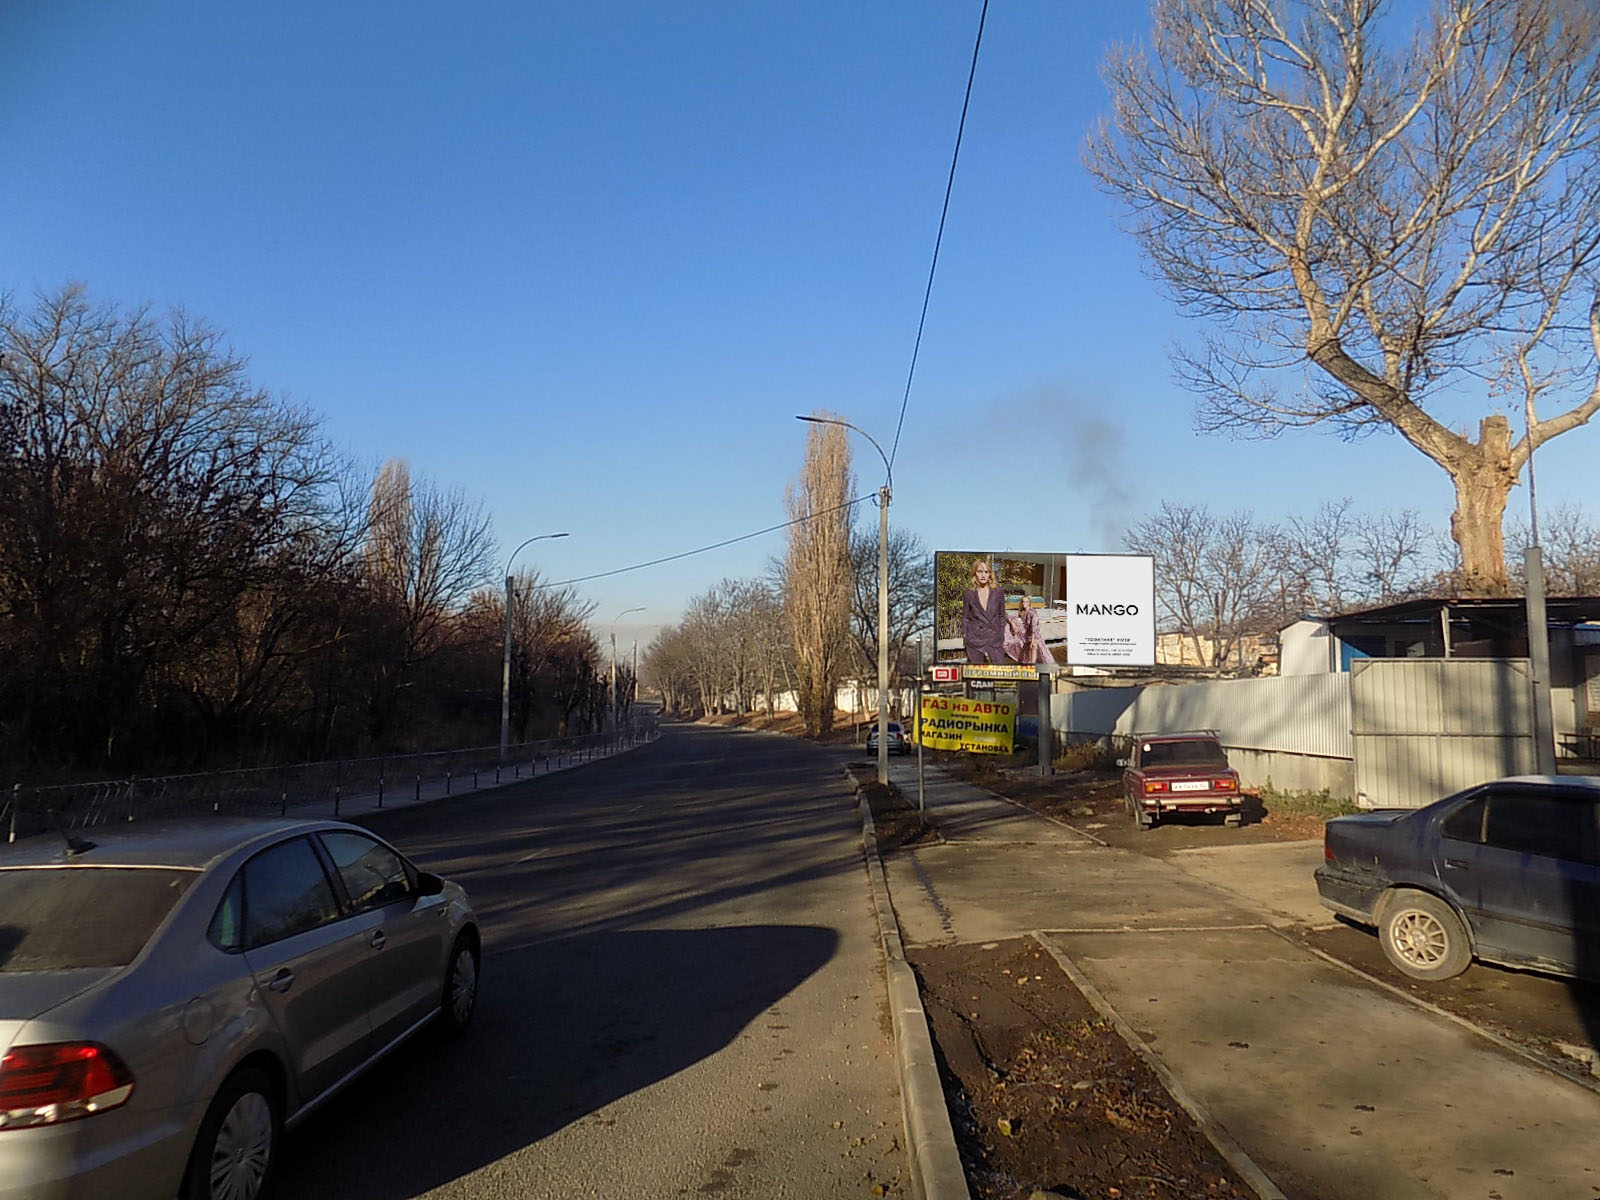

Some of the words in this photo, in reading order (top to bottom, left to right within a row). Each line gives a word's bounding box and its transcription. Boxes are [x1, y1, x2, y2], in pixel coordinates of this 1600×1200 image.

[1076, 603, 1139, 616] MANGO
[964, 669, 1019, 679] ОГРОМНЫЙ
[970, 680, 994, 688] СДАМ
[922, 698, 948, 710] ГАЗ
[952, 703, 969, 712] на
[973, 703, 1010, 715] АВТО
[920, 718, 1009, 734] РАДИОРЫНКА
[960, 742, 1009, 753] УСТАНОВКА
